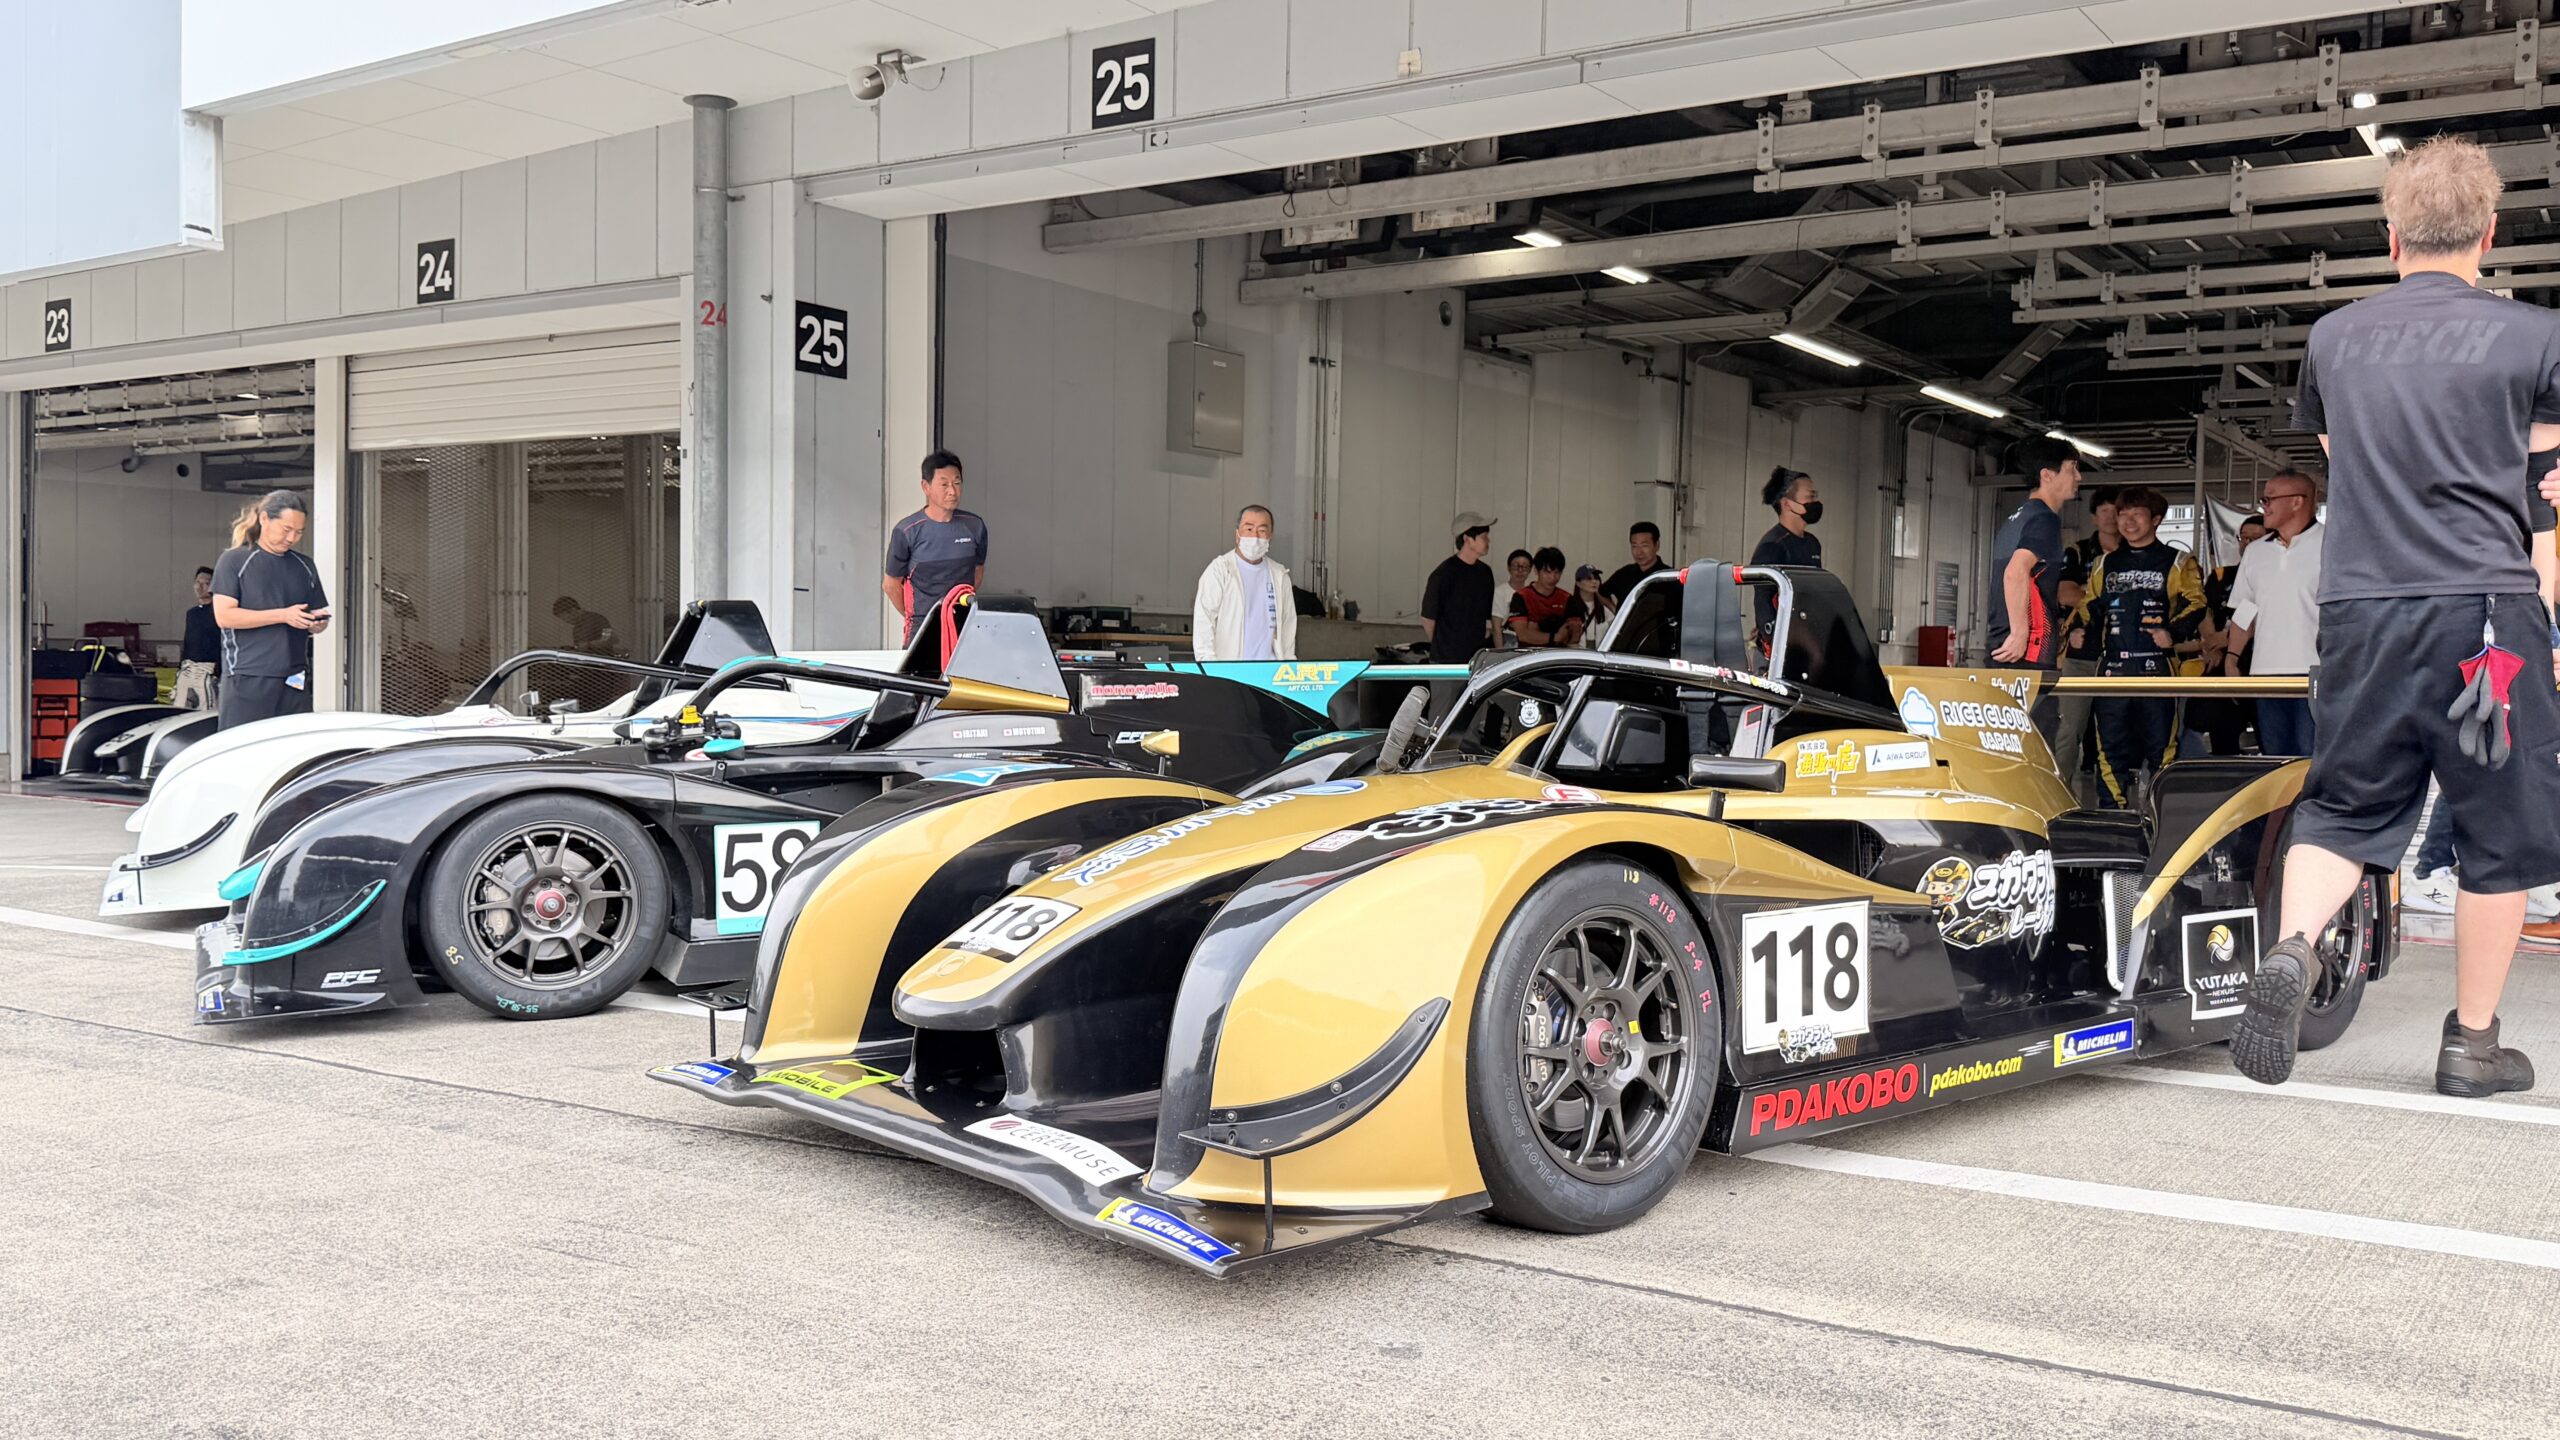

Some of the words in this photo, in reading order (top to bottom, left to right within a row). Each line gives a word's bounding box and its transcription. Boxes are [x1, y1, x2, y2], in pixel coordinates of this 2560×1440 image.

[1095, 53, 1150, 117] 25
[420, 250, 452, 294] 24
[46, 308, 70, 346] 23
[700, 300, 727, 327] 24
[800, 315, 845, 367] 25
[1273, 664, 1339, 682] ART
[1941, 702, 1984, 726] RICE
[1984, 705, 2032, 732] CLOUD
[1905, 750, 1927, 760] GROUP
[1980, 732, 2022, 753] JAPAN
[1624, 869, 1640, 884] 118
[969, 902, 1058, 941] 118
[1649, 893, 1677, 924] #118
[1699, 990, 1713, 1013] FL
[323, 969, 381, 984] PFC
[1751, 921, 1860, 1025] 118
[2195, 971, 2248, 990] YUTAKA
[2212, 988, 2235, 996] NEXUS
[1537, 1014, 1549, 1082] wilood
[2077, 1030, 2127, 1052] MICHELIN
[1503, 1073, 1526, 1137] SPORT
[1750, 1063, 1919, 1136] PDAKOBO
[1929, 1055, 2022, 1097] pdakobo.com
[1010, 1129, 1120, 1177] CEREMUSE
[1521, 1143, 1556, 1187] PILOT
[1134, 1214, 1219, 1253] MICHELIN
